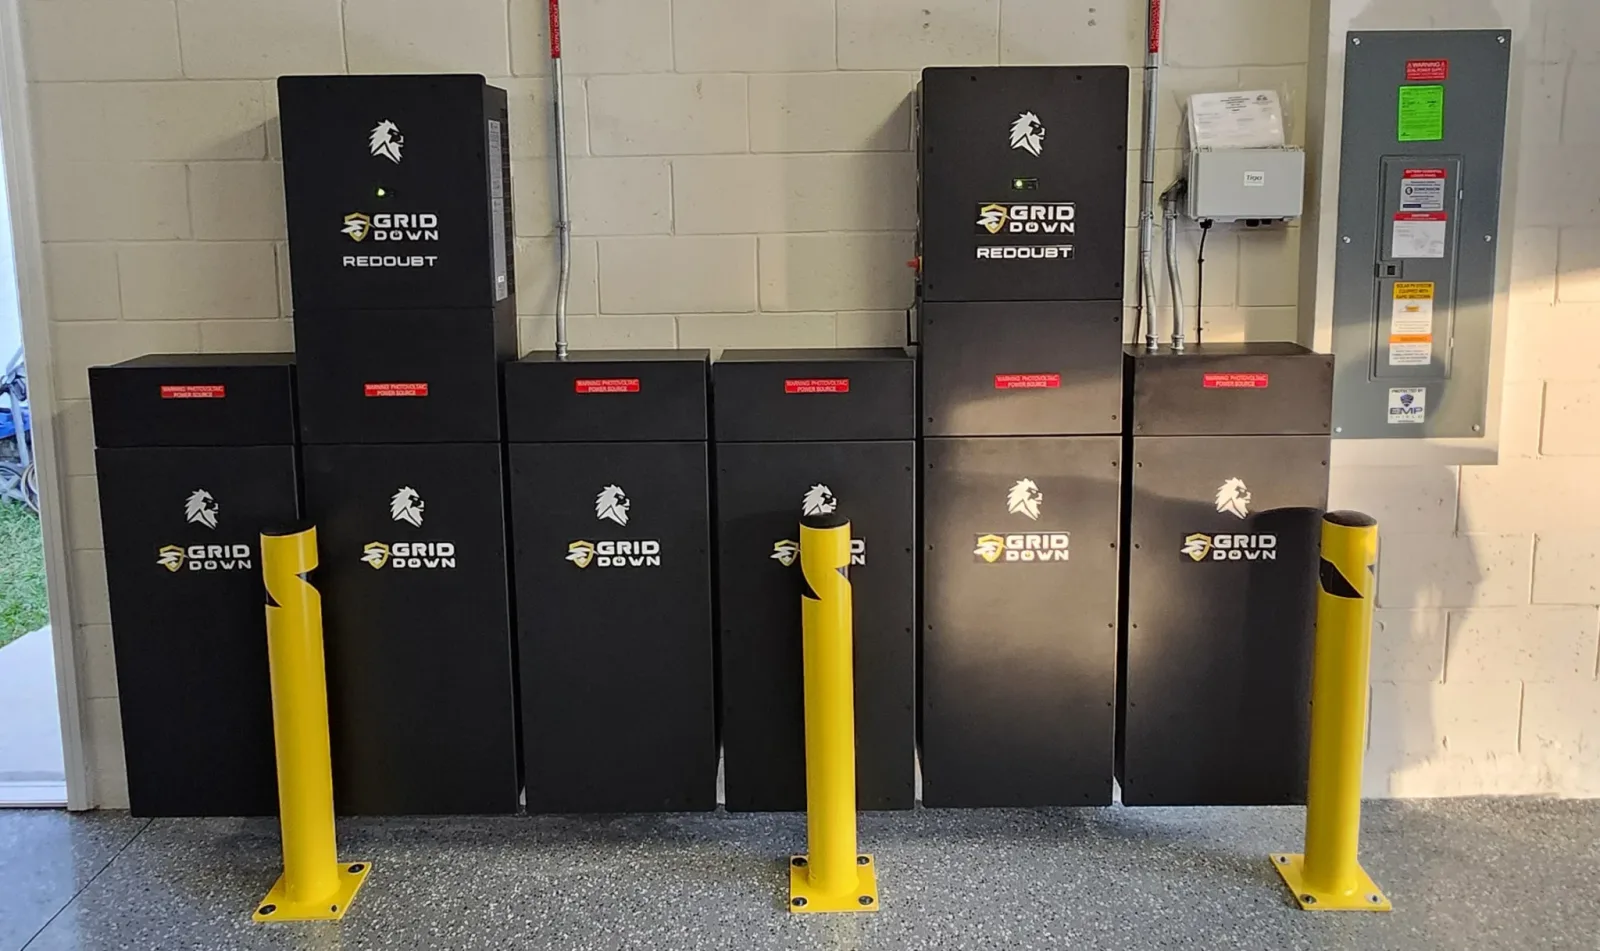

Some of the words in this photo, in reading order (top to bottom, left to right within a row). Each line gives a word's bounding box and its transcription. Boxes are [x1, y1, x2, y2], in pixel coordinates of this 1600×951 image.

[1010, 206, 1074, 220] GRID
[374, 214, 438, 228] GRID
[1010, 222, 1075, 233] DOWN
[374, 230, 439, 241] DOWN
[977, 247, 1072, 259] REDOUBT
[343, 256, 438, 267] REDOUBT
[1389, 407, 1423, 415] EMP
[1006, 535, 1069, 550] GRID
[1213, 535, 1277, 549] GRID
[188, 545, 250, 559] GRID
[392, 543, 455, 557] GRID
[597, 541, 660, 555] GRID
[1006, 550, 1069, 561] DOWN
[1213, 550, 1276, 560] DOWN
[189, 560, 252, 570] DOWN
[392, 558, 456, 568] DOWN
[597, 556, 660, 567] DOWN
